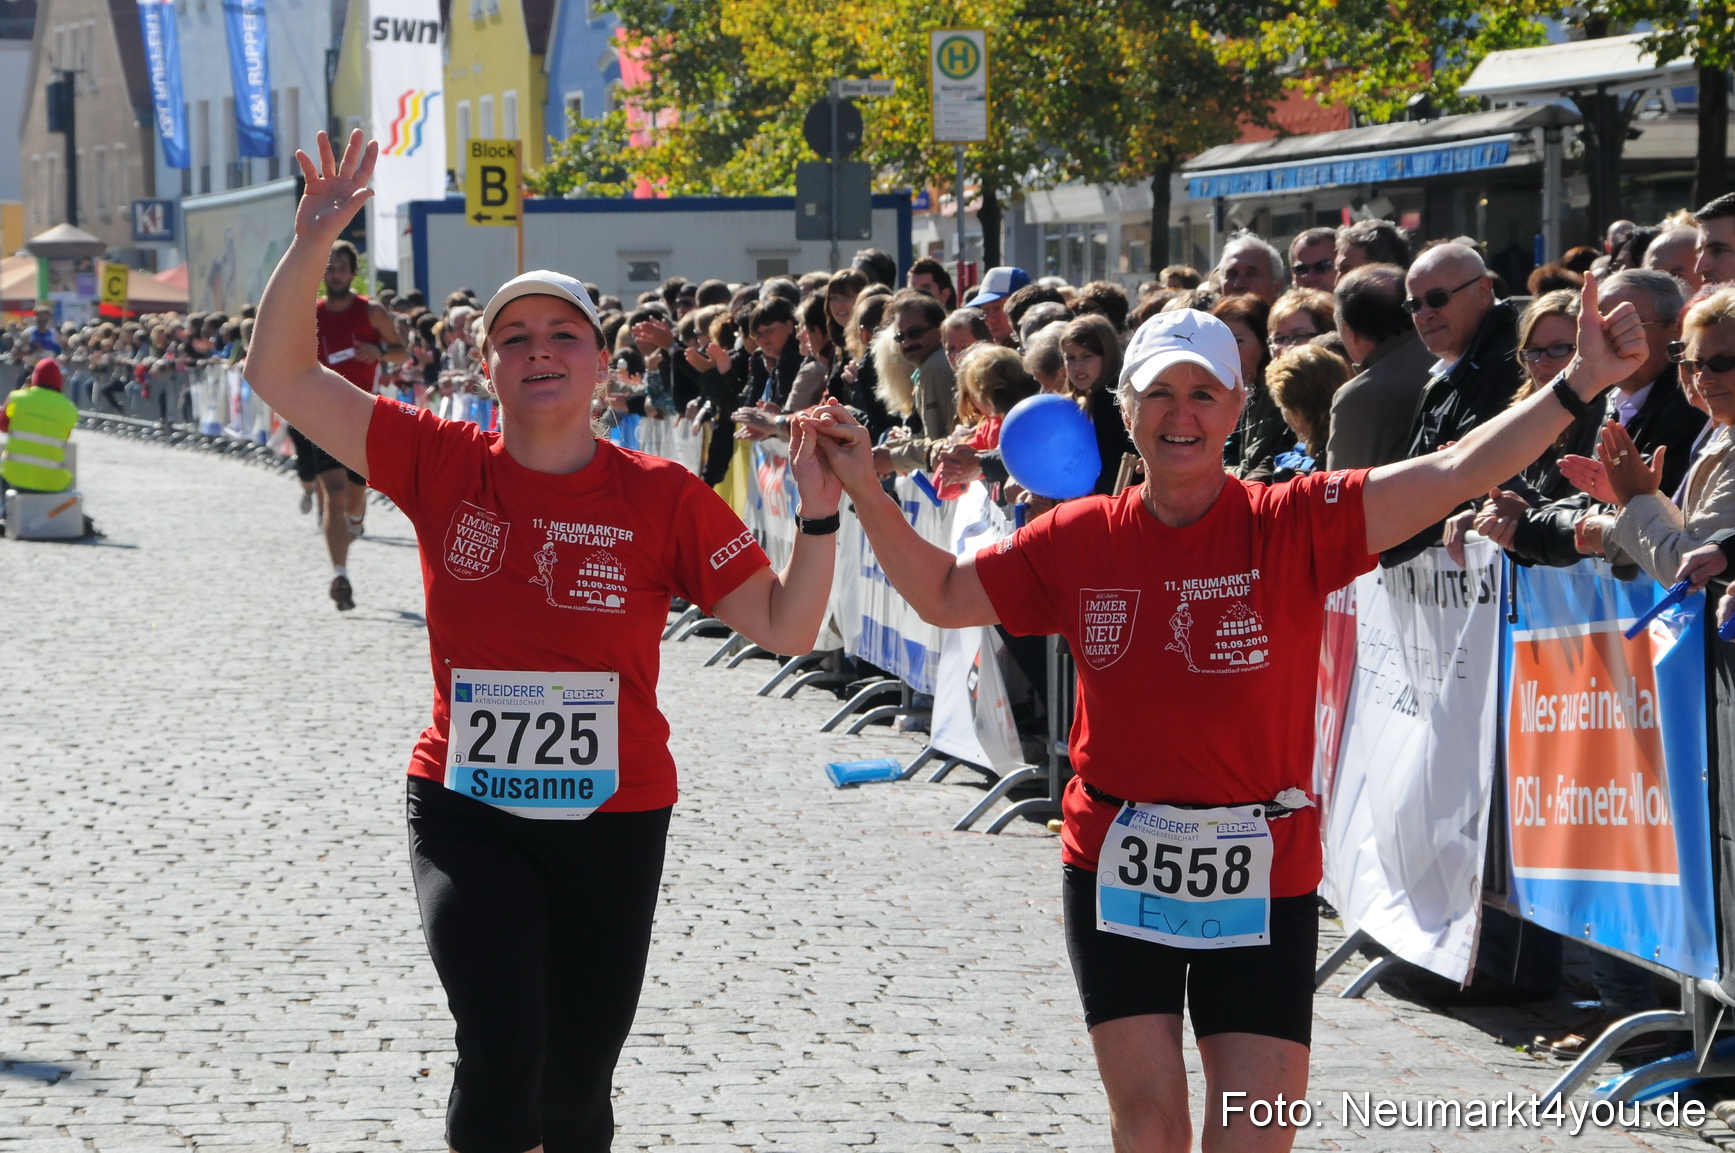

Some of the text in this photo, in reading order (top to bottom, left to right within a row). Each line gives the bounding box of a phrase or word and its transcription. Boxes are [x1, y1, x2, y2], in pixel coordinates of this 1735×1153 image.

[373, 15, 438, 44] swn
[948, 46, 969, 70] H
[249, 88, 269, 127] K&L
[471, 142, 516, 158] Block
[480, 165, 508, 207] B
[107, 276, 121, 296] C
[460, 513, 501, 537] IMMER
[532, 518, 634, 542] 11. NEUMARKTER
[456, 523, 499, 550] WIEDER
[545, 530, 617, 548] STADTLAUF
[451, 537, 495, 564] NEU
[709, 529, 757, 571] BOC
[447, 552, 490, 574] MARKT
[576, 579, 628, 593] 19.09.2010
[1164, 568, 1261, 592] 11. NEUMARKTR
[1180, 584, 1251, 602] STADTLAUF
[558, 604, 627, 615] www.stadtlauf-neumarkt.de
[1085, 600, 1127, 612] IMMER
[1084, 613, 1128, 625] WIEDER
[1085, 625, 1123, 643] NEU
[1214, 635, 1269, 650] 19.09.2010
[1084, 644, 1120, 656] MARKT
[1201, 662, 1271, 675] www.stadtlauf-neumarkt.de
[474, 683, 605, 700] PFLEIDERER BOCK
[474, 698, 545, 706] AKTIENGESELLSCHAFT
[467, 709, 599, 766] 2725
[455, 754, 462, 764] D
[470, 768, 594, 801] Susanne
[1515, 776, 1546, 826] DSL
[1130, 823, 1200, 842] AKTIENGESELLSCHAFT
[1133, 812, 1257, 835] PFLEIDERER BOCK
[1118, 835, 1252, 898] 3558
